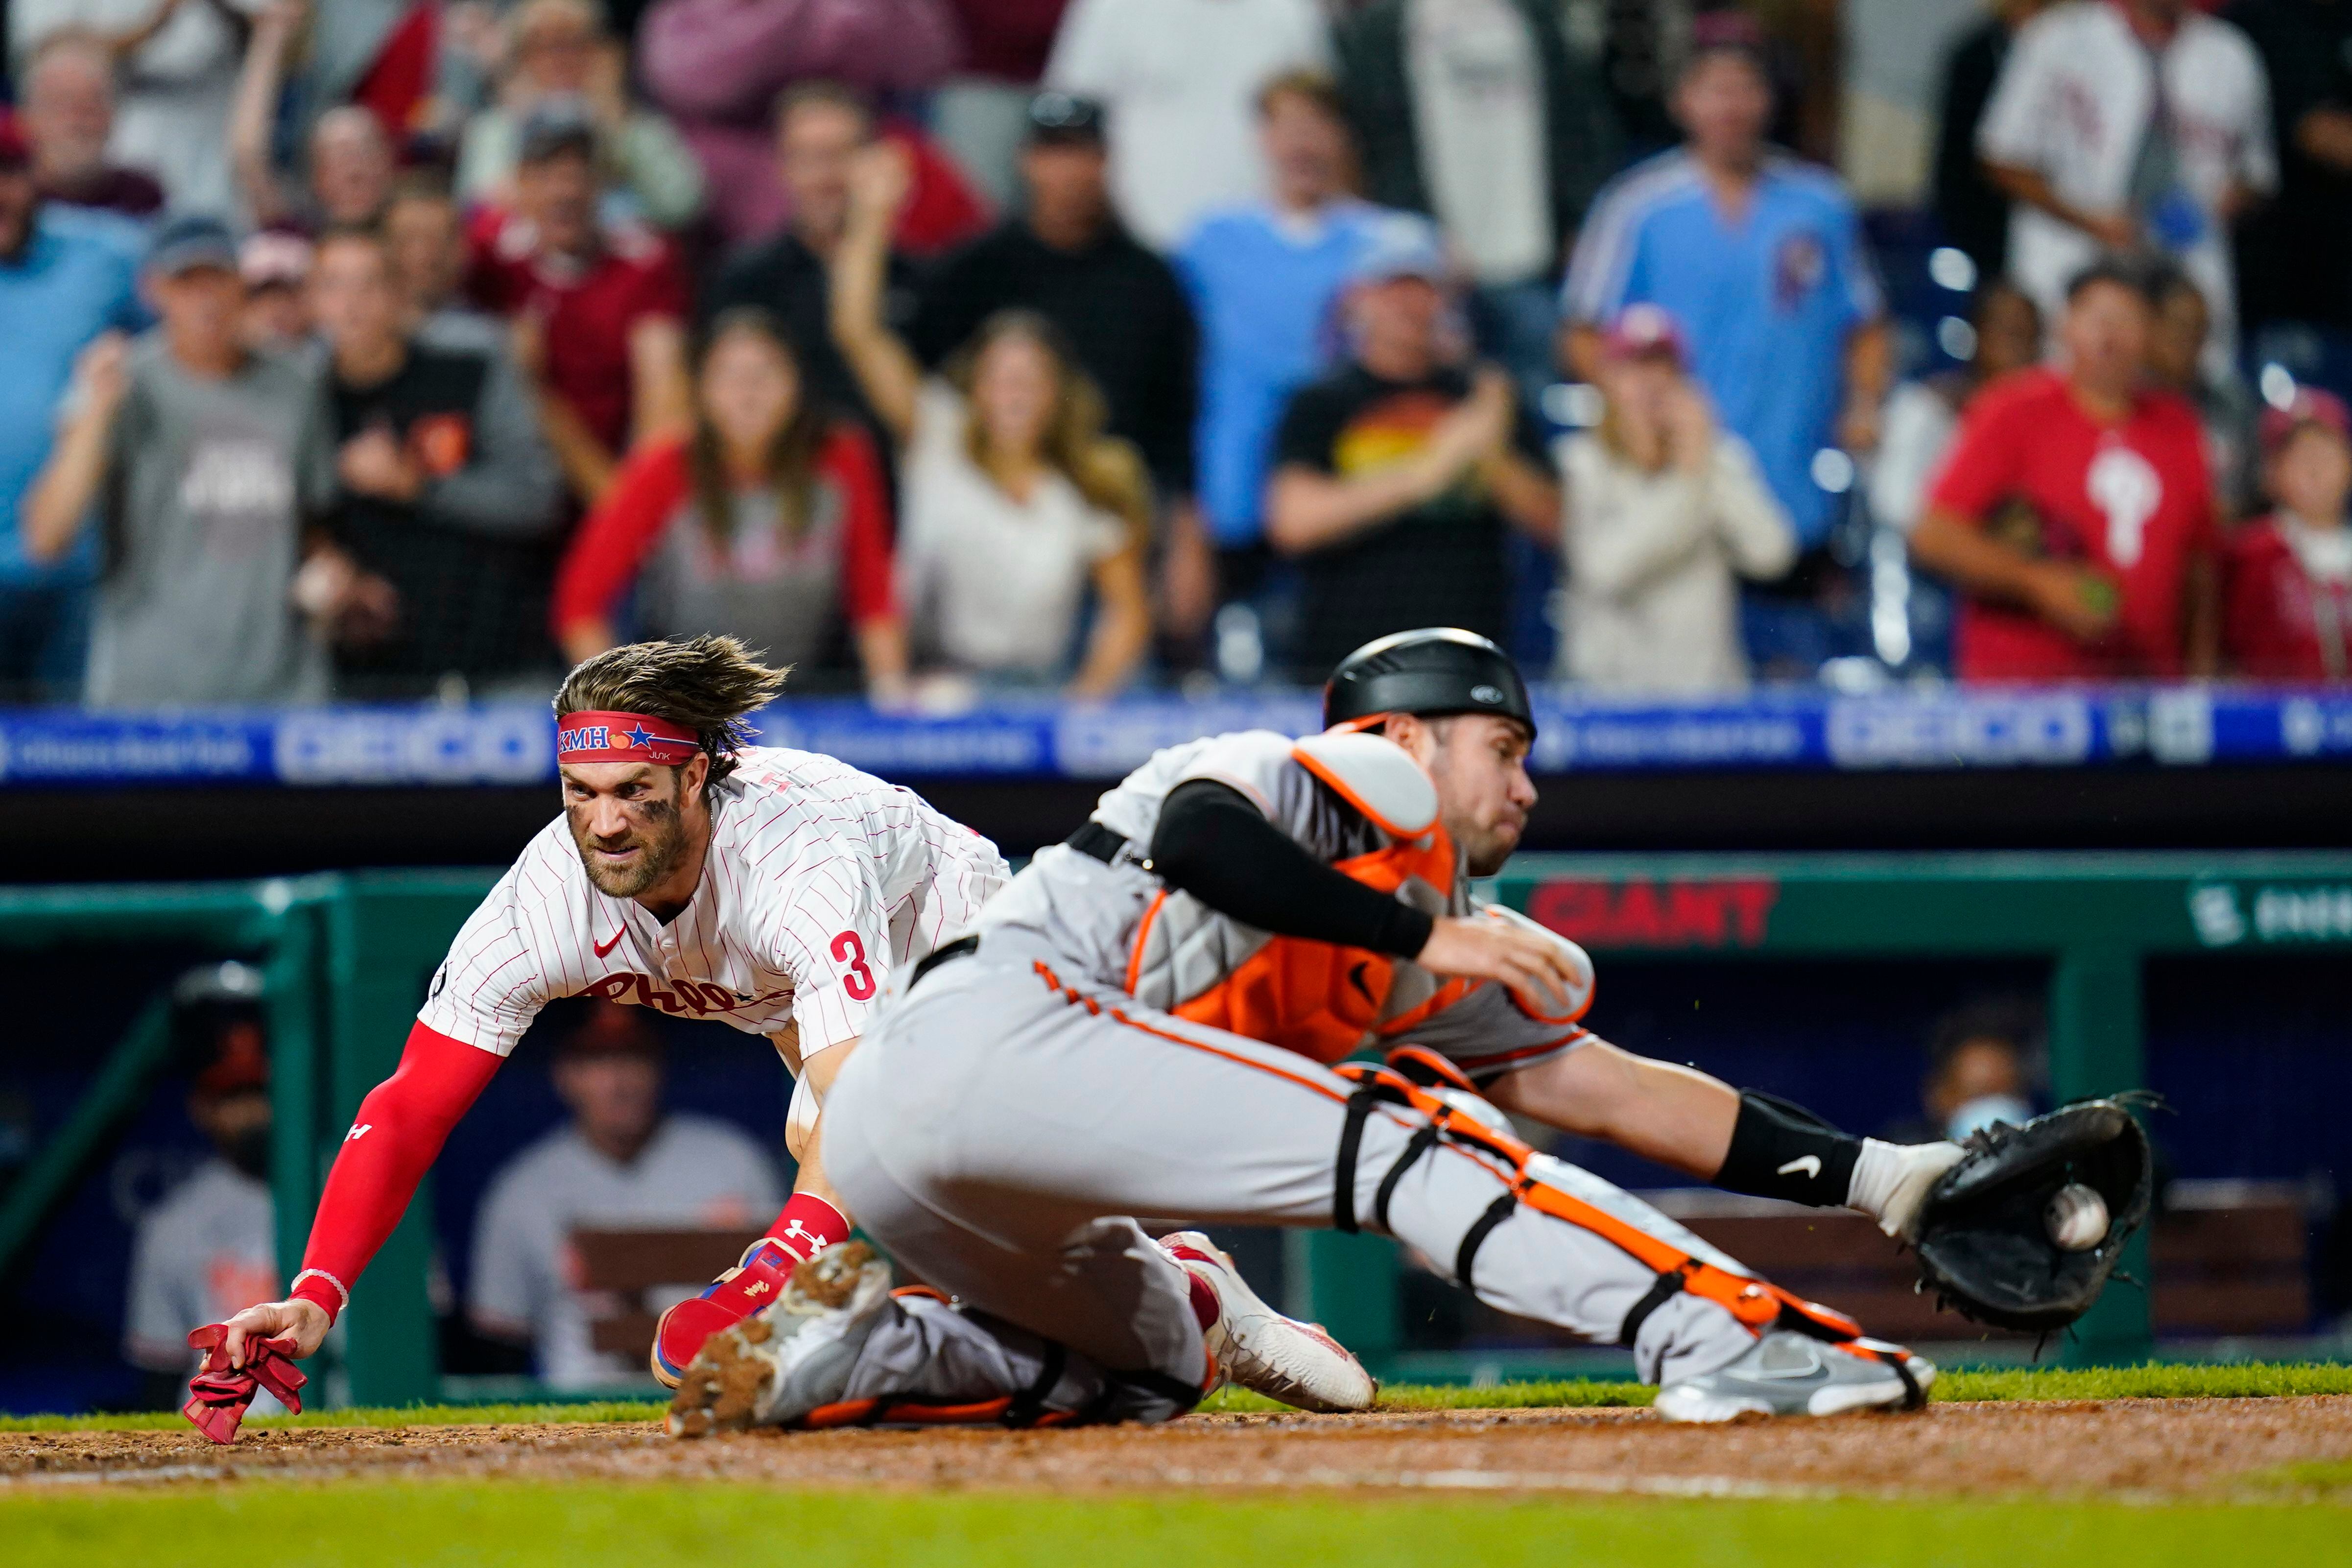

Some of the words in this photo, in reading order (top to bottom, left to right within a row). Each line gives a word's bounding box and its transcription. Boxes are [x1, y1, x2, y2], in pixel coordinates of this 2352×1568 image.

[649, 751, 671, 760] JUNK
[1528, 878, 1777, 946] GIANT
[830, 930, 877, 1001] 3
